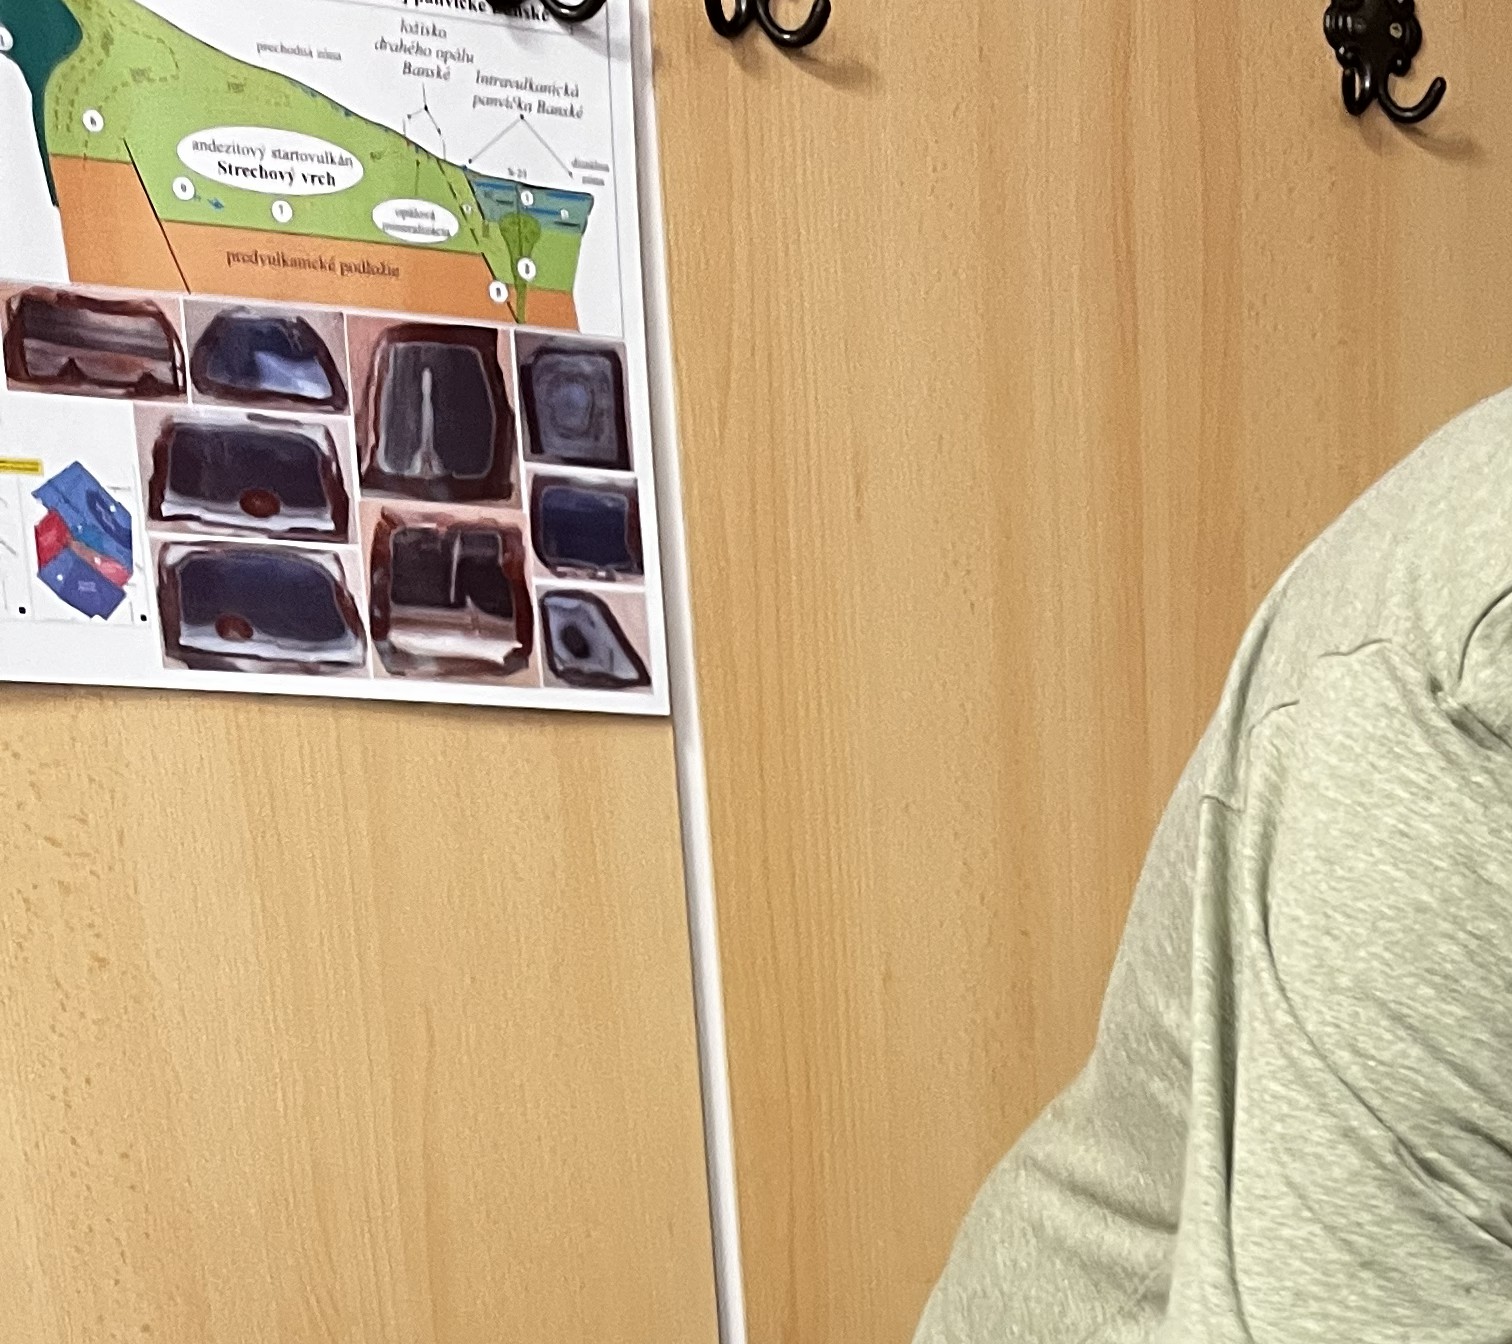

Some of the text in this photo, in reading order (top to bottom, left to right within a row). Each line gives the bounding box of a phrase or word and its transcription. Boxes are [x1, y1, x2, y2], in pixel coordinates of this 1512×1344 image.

[402, 60, 451, 82] Banské
[192, 139, 267, 161] andezitový
[217, 160, 337, 188] Strechový vrch
